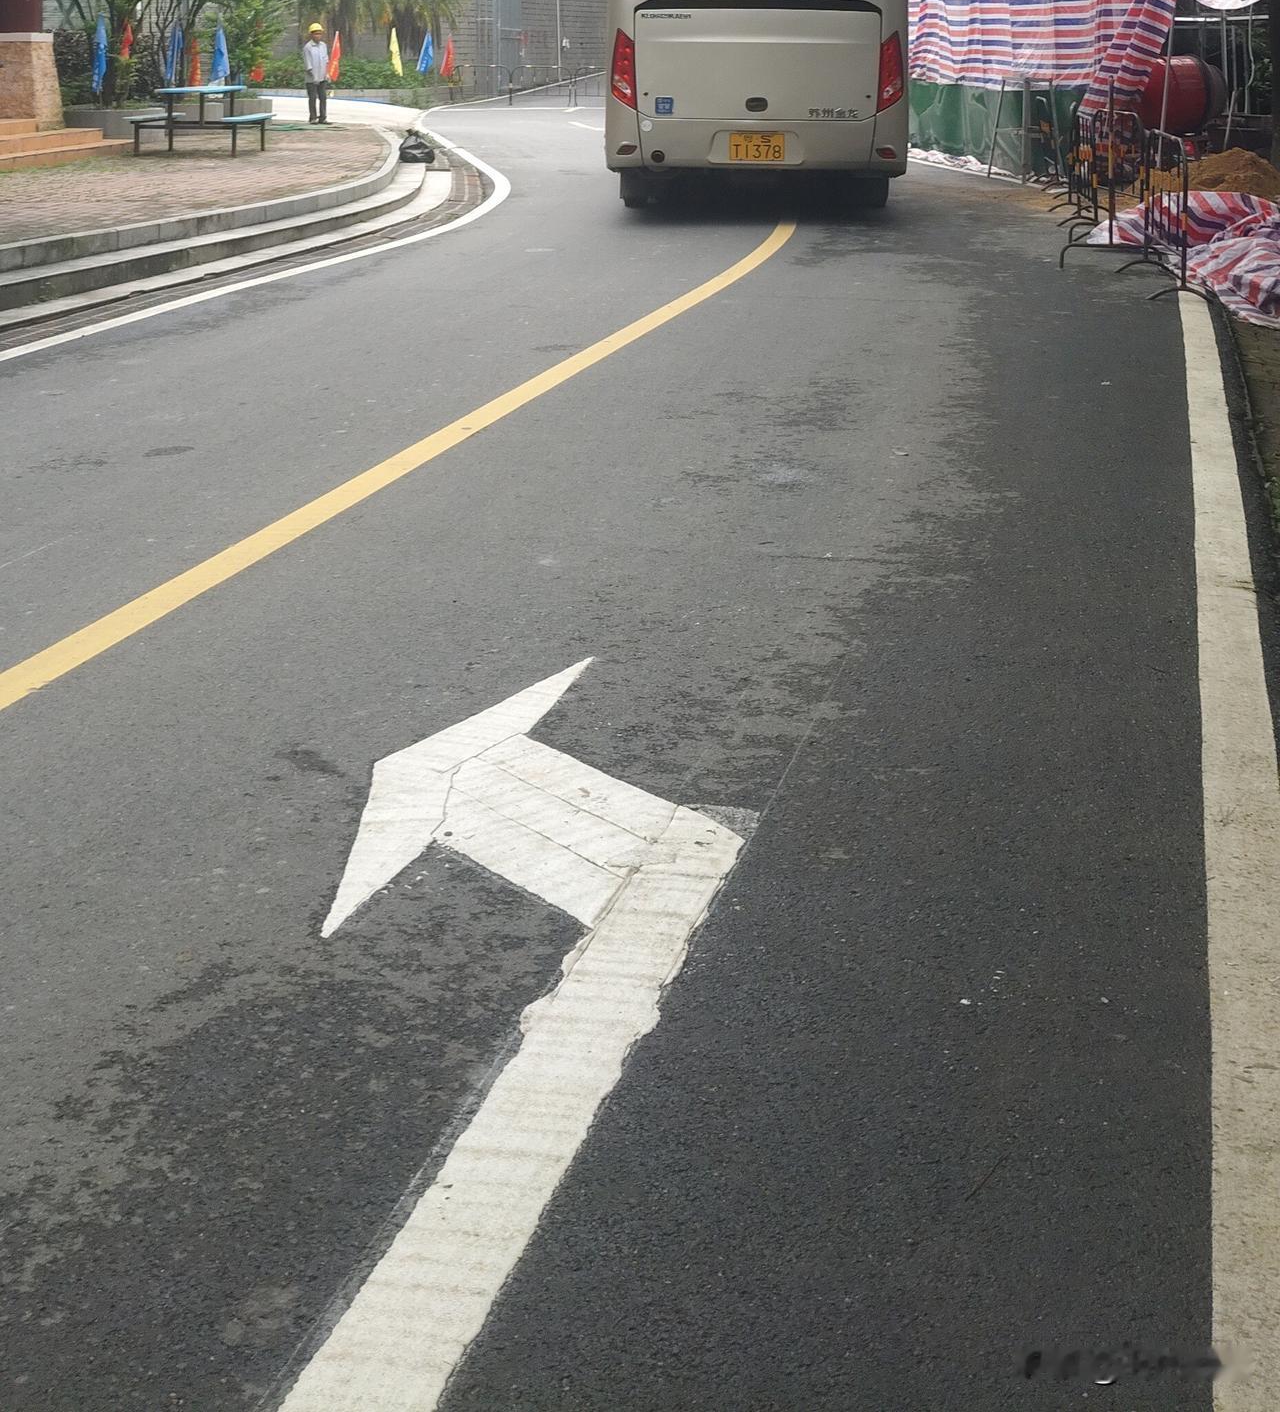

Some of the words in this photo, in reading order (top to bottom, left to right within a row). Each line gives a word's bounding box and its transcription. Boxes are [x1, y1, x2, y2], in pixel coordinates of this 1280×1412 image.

[808, 107, 859, 119] 苏州金龙
[733, 144, 782, 159] T1378
